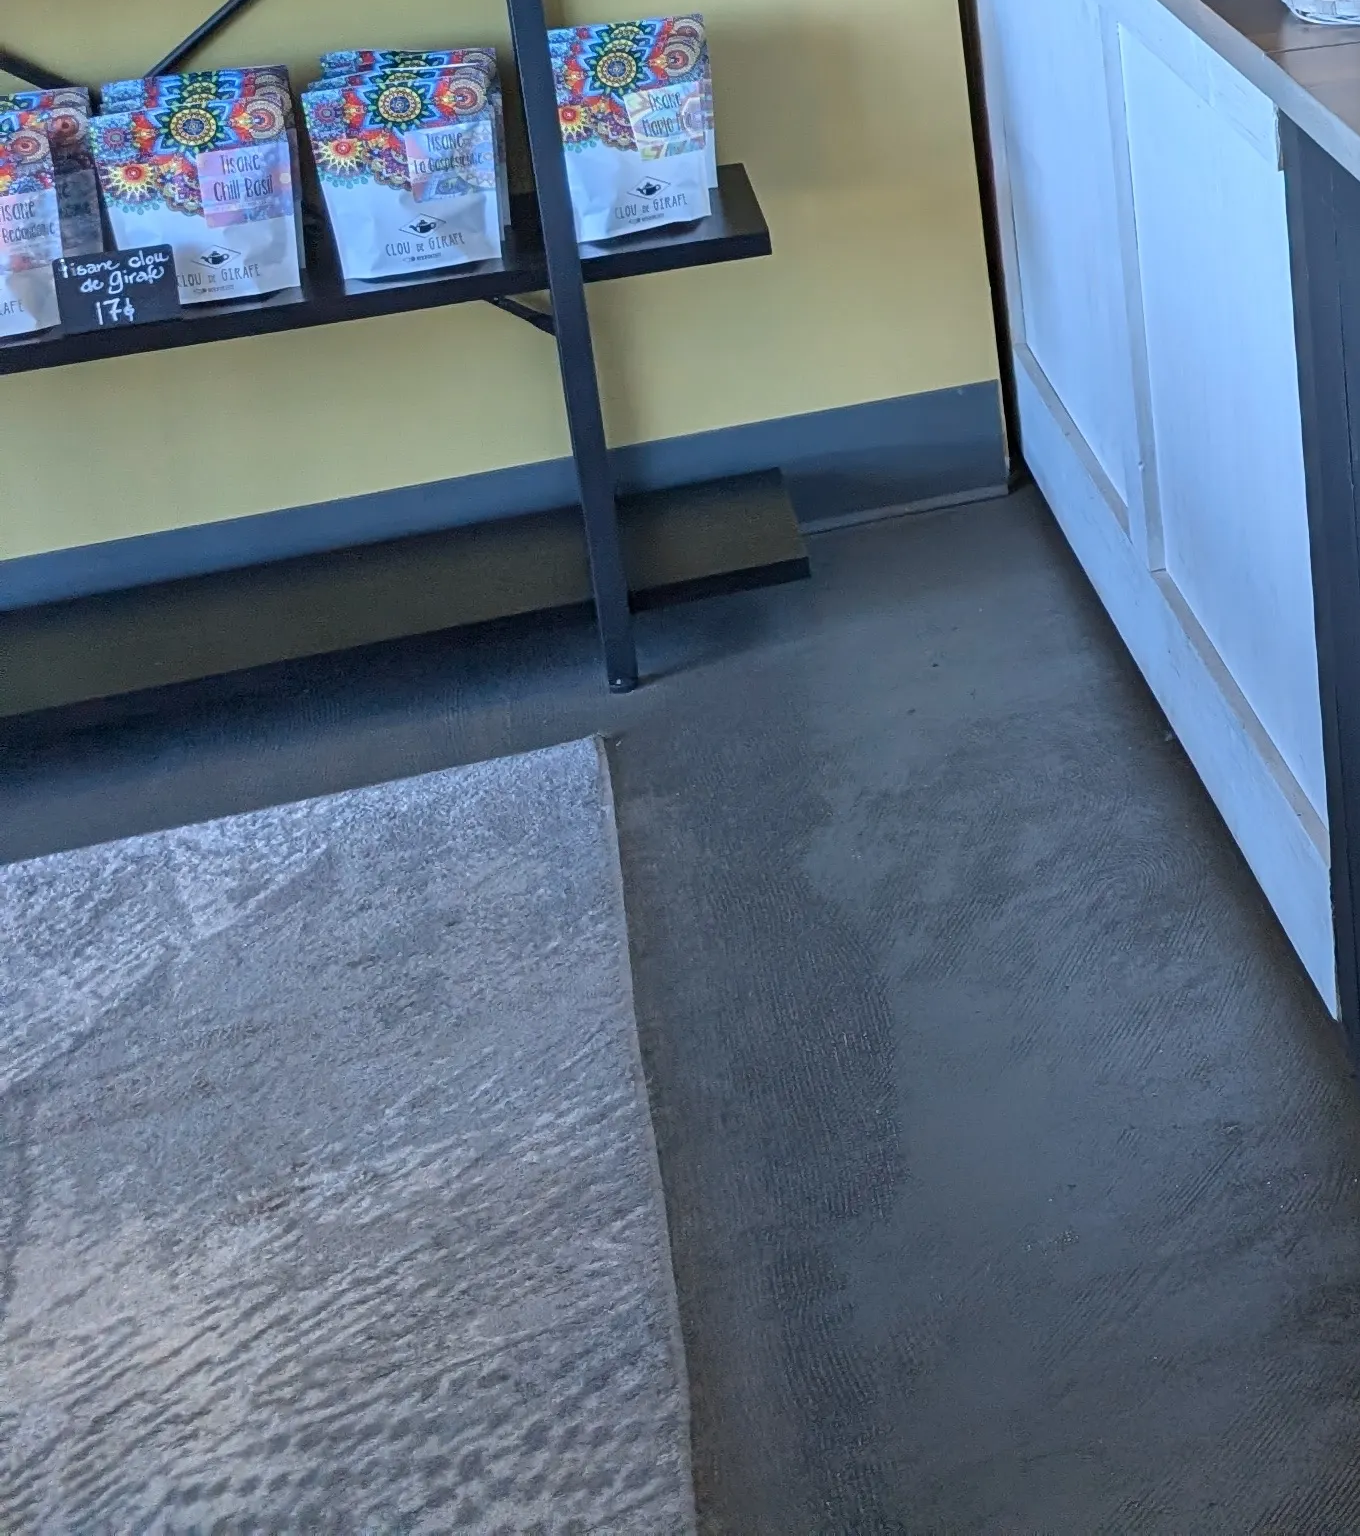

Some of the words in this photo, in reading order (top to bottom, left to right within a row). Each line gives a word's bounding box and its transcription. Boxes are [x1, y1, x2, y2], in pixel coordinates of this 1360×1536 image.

[648, 91, 681, 113] Tisane
[426, 132, 463, 153] Tisane
[220, 153, 261, 176] Tisane
[213, 179, 241, 202] Chill
[244, 174, 274, 198] Basil
[614, 204, 638, 221] CLOU
[652, 193, 688, 212] GIRAFE
[385, 242, 411, 257] CLOU
[427, 231, 465, 251] GIRAFE
[59, 258, 121, 279] tisane
[127, 249, 170, 268] clou
[221, 263, 261, 282] GIRAFE
[79, 278, 105, 294] de
[107, 264, 165, 294] girafe
